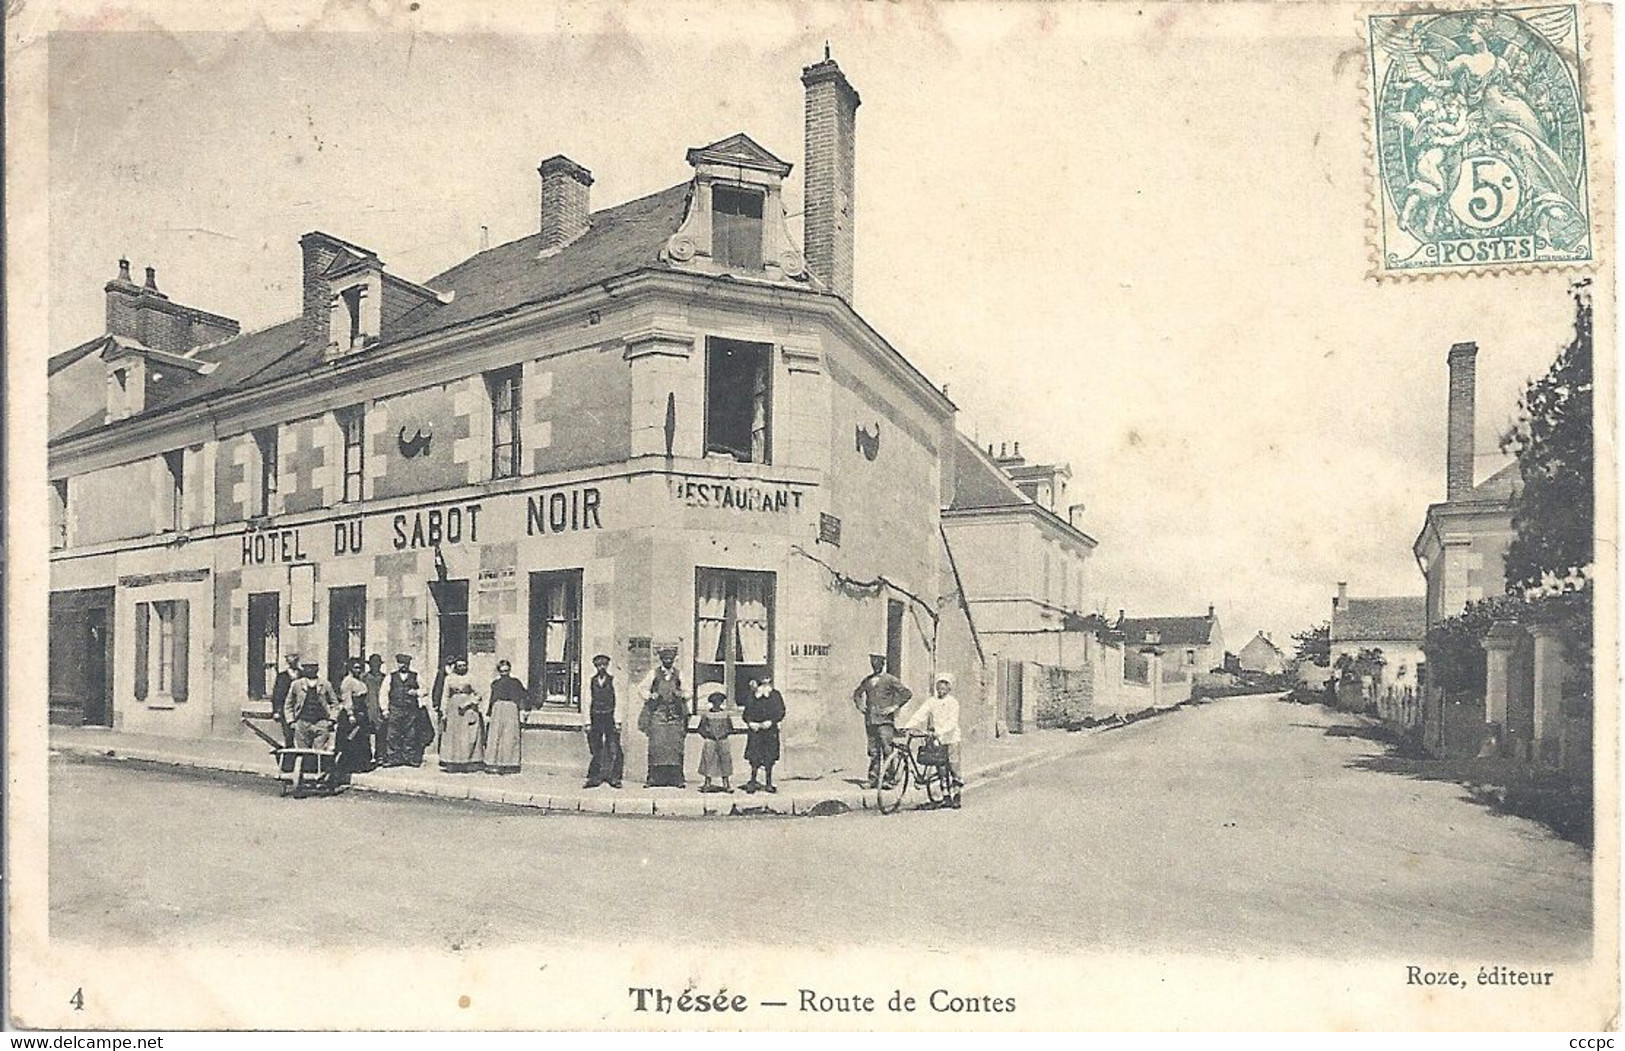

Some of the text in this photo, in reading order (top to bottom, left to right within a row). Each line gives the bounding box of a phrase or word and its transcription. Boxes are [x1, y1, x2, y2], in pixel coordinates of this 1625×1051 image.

[1441, 238, 1531, 263] POSTES
[334, 519, 363, 556] DU
[393, 504, 482, 549] SABOT
[526, 487, 602, 536] NOIR
